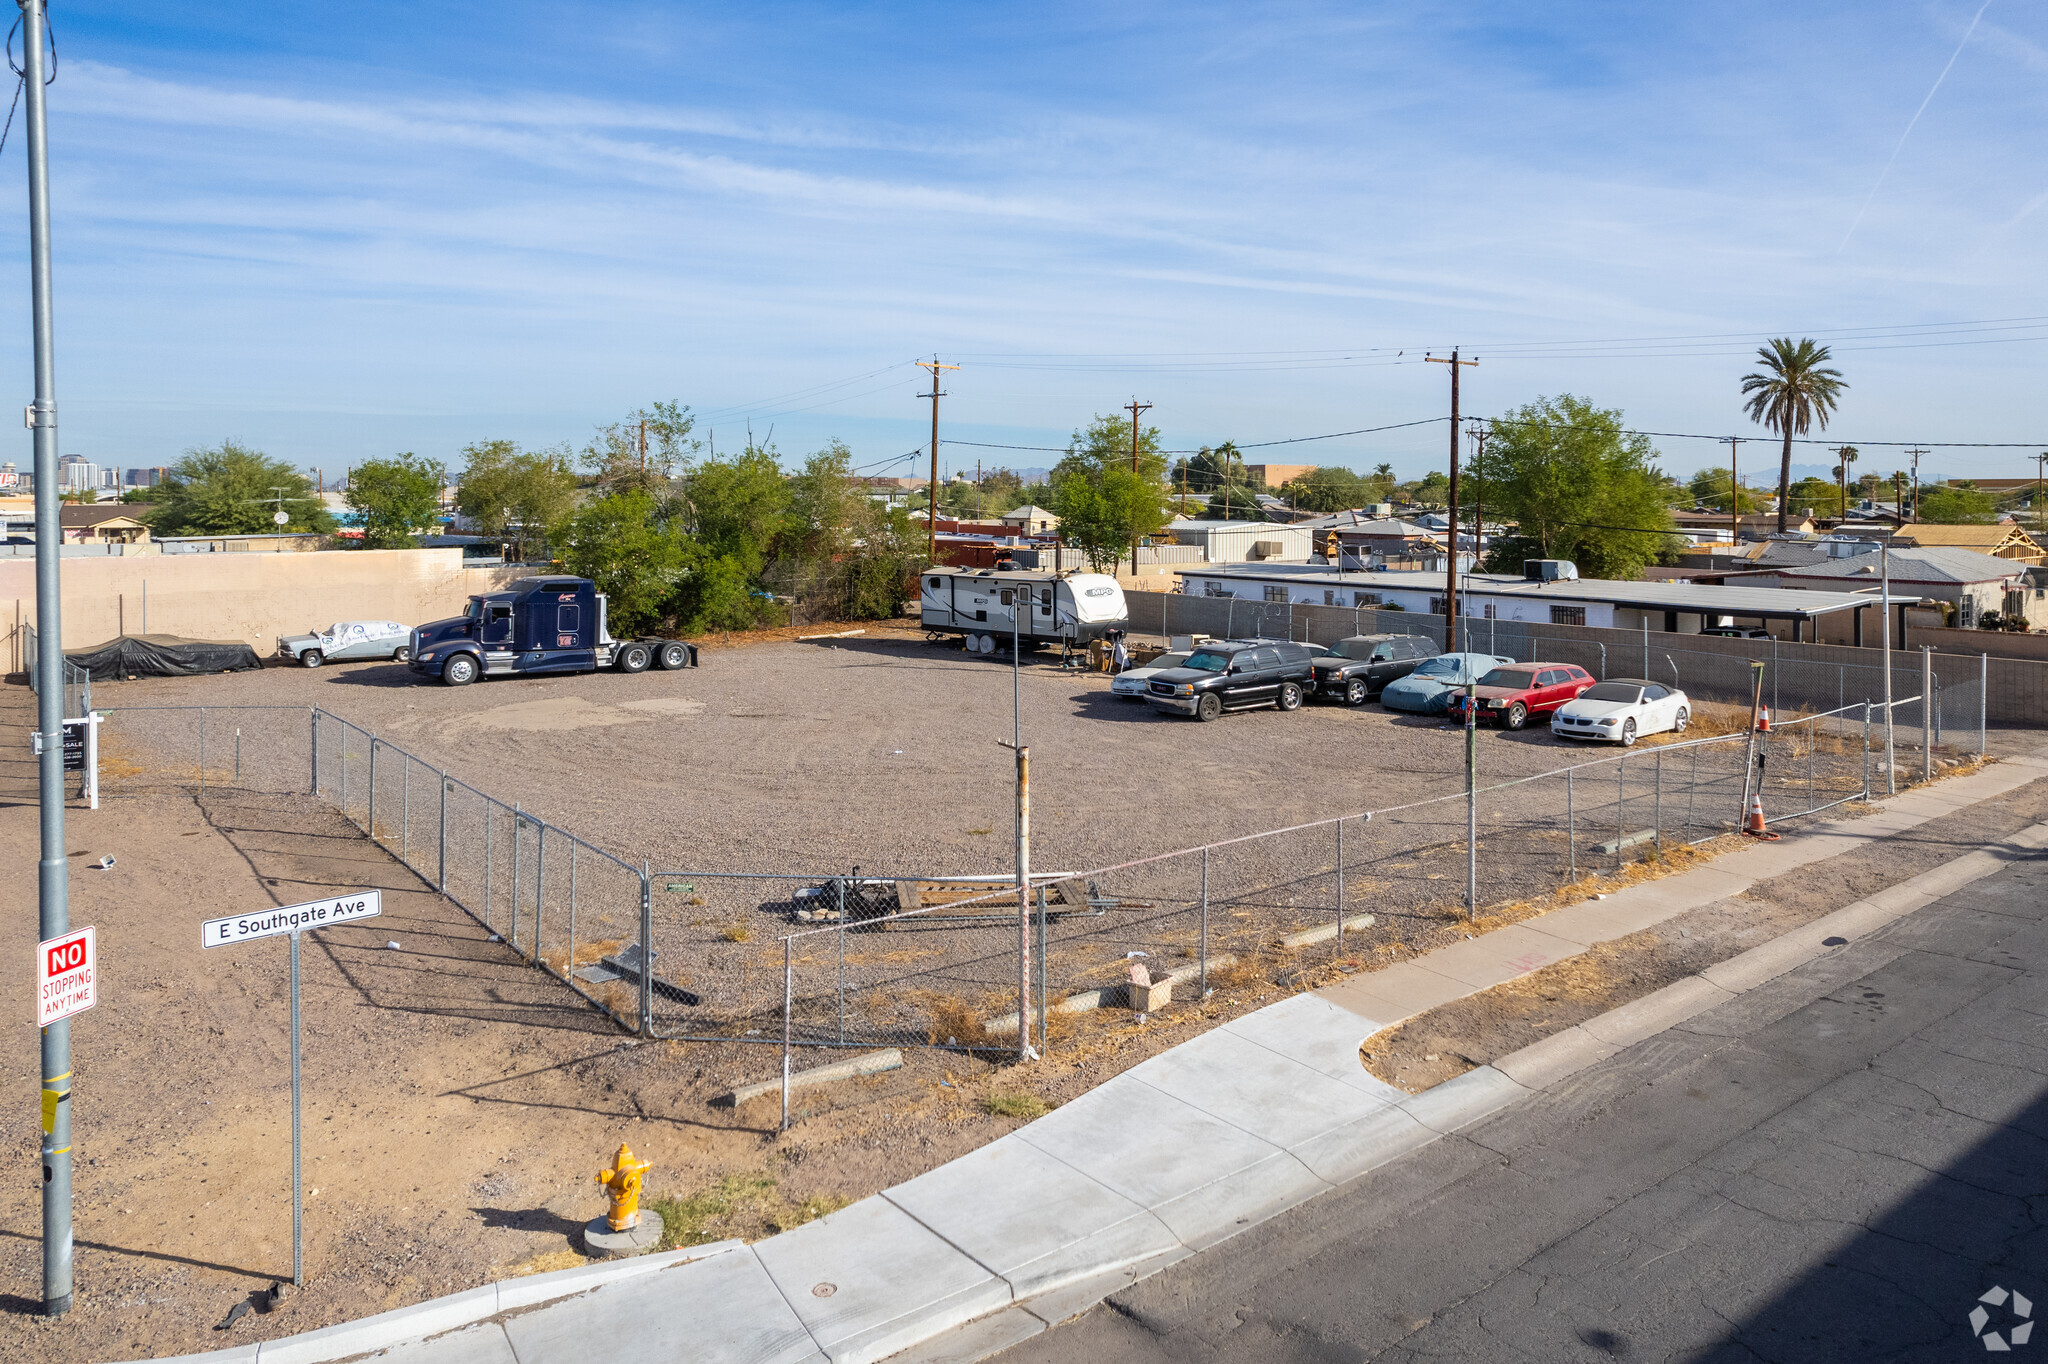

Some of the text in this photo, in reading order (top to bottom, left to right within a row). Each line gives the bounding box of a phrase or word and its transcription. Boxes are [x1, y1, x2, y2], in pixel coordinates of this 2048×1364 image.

[1092, 587, 1112, 597] MPG
[220, 901, 366, 939] E Southgate Ave
[52, 943, 82, 973] NO
[43, 968, 92, 1000] STOPPING
[45, 987, 90, 1016] ANYTIME
